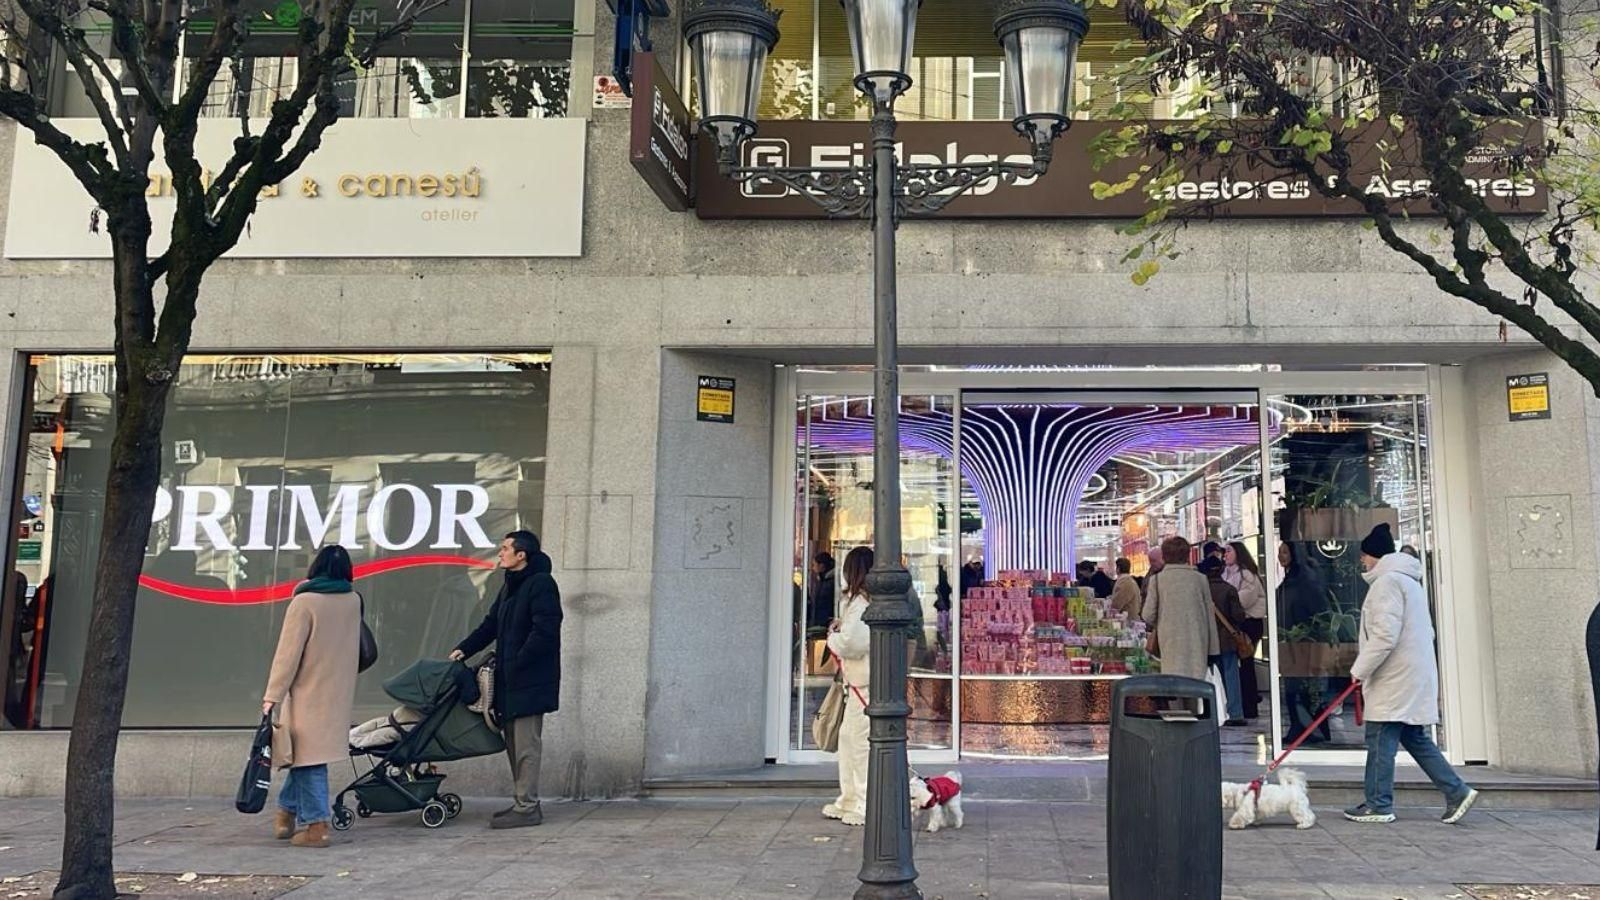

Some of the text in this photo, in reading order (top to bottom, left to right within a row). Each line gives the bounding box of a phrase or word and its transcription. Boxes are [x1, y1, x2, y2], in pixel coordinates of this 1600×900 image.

[301, 176, 319, 198] &
[338, 166, 481, 197] canesú
[811, 142, 1039, 195] Fialgo
[1364, 174, 1536, 199] Aseores
[421, 208, 479, 222] atelier
